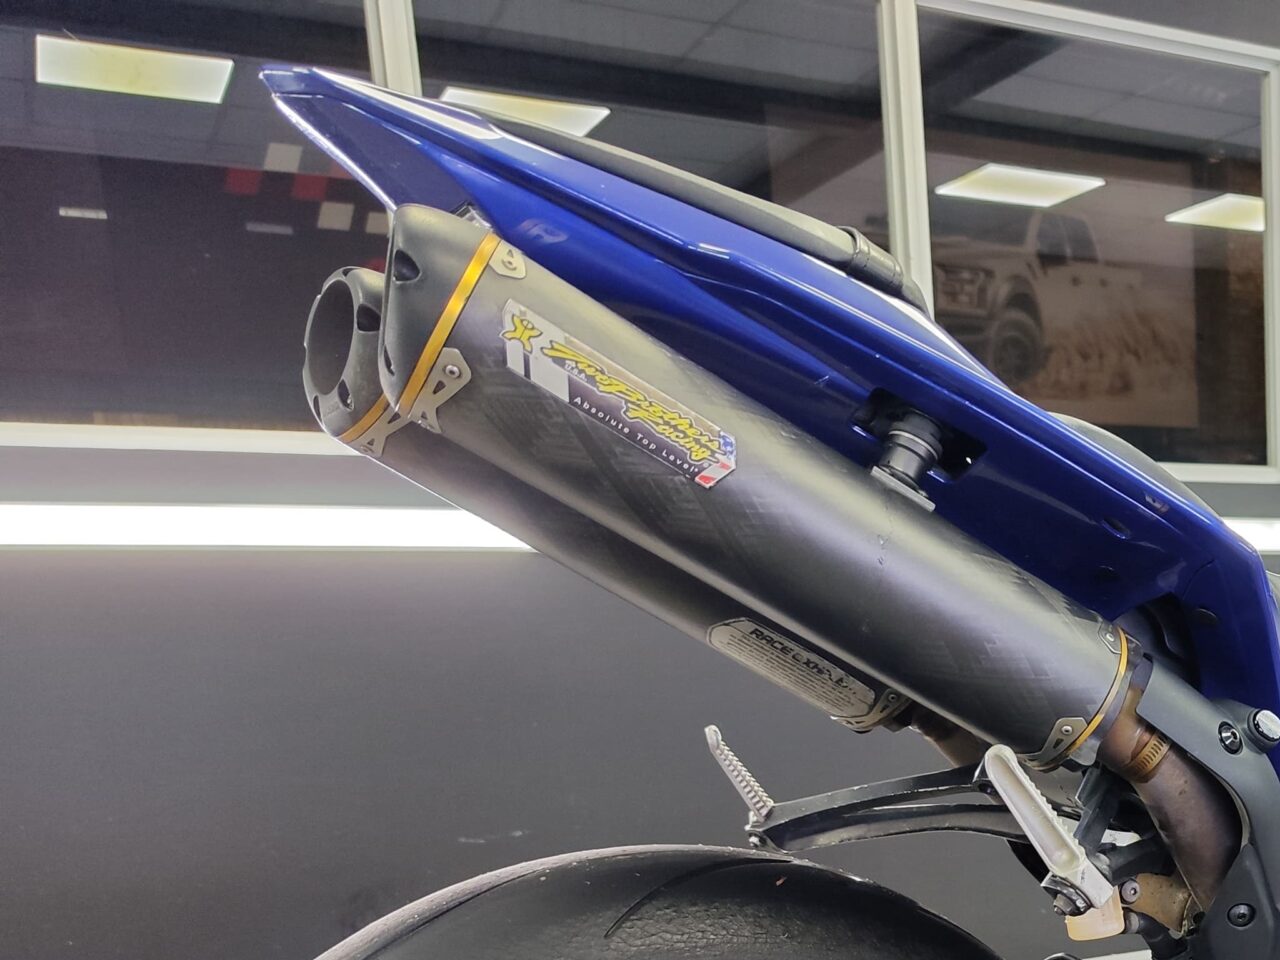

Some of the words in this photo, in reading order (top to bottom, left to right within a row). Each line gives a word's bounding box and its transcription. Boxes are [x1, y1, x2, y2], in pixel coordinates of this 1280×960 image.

[573, 396, 631, 434] Absolute
[636, 433, 657, 451] Top
[627, 403, 719, 462] Racing
[749, 628, 794, 656] RACE
